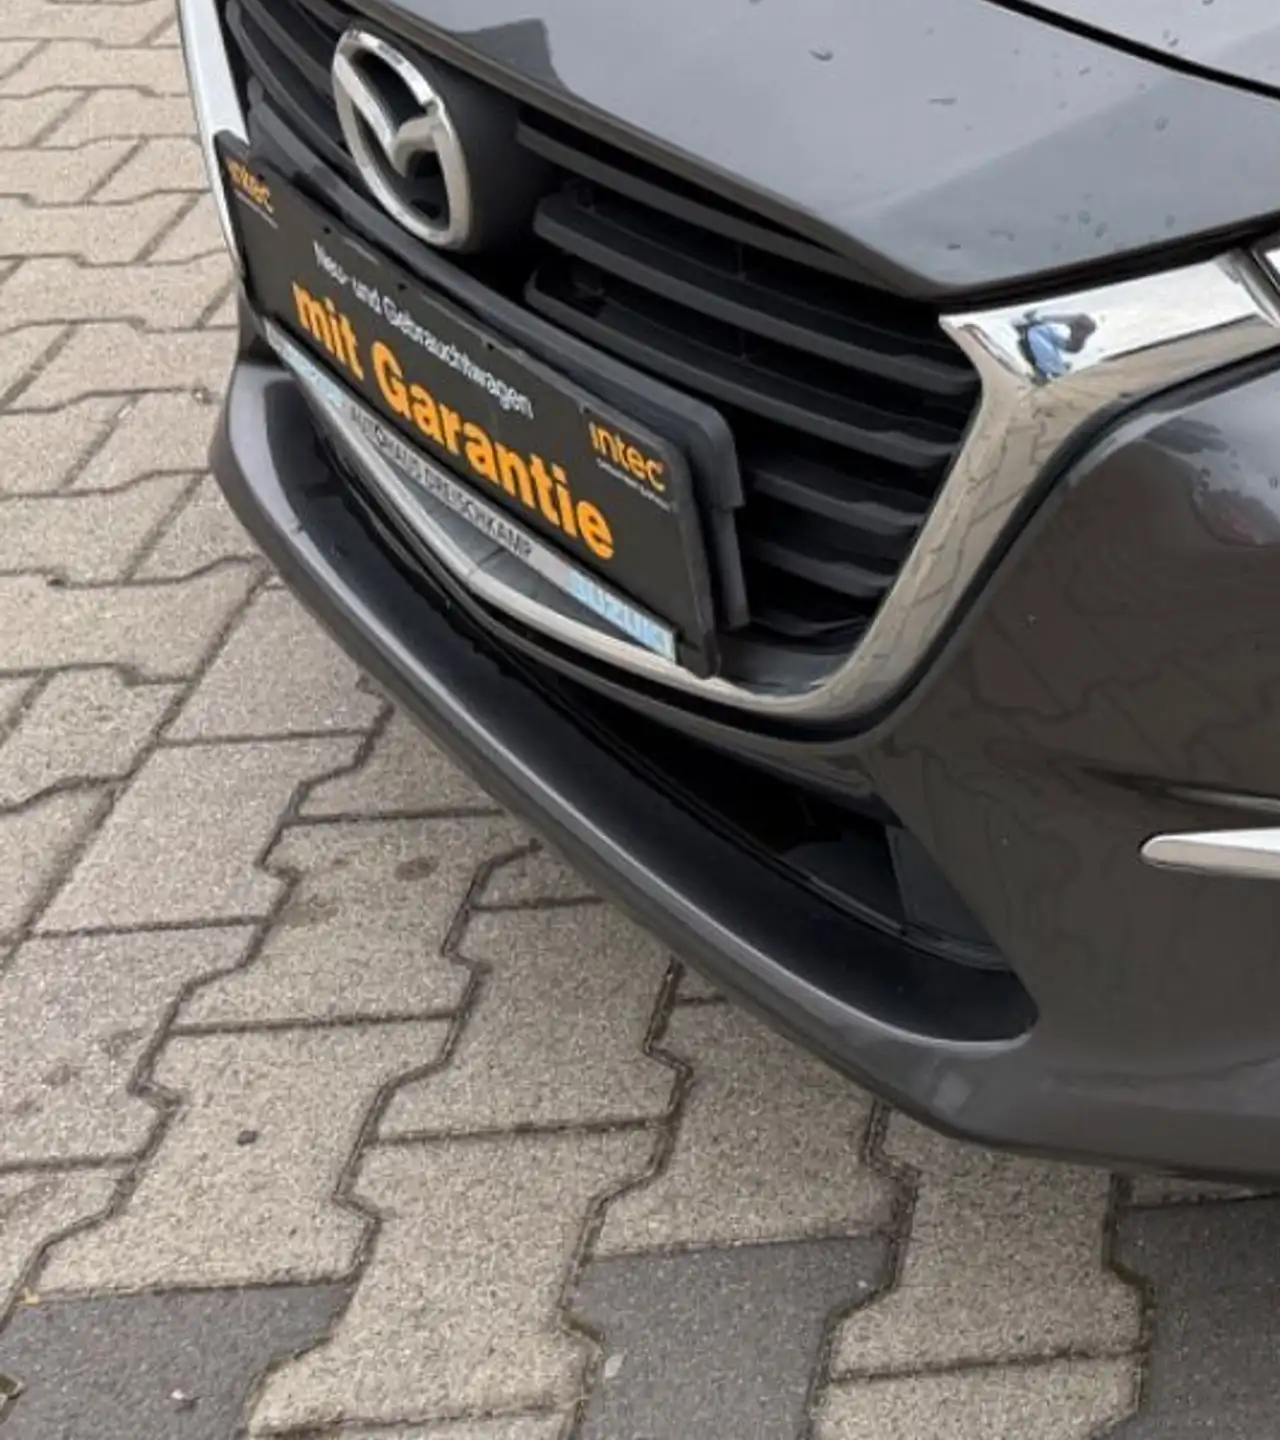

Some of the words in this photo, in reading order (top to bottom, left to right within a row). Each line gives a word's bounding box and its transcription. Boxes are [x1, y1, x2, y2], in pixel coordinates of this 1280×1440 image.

[291, 279, 366, 381] mit
[370, 339, 615, 560] Garantie
[351, 275, 383, 316] und
[382, 294, 535, 420] Gebrauchtwagen
[588, 420, 667, 493] intec
